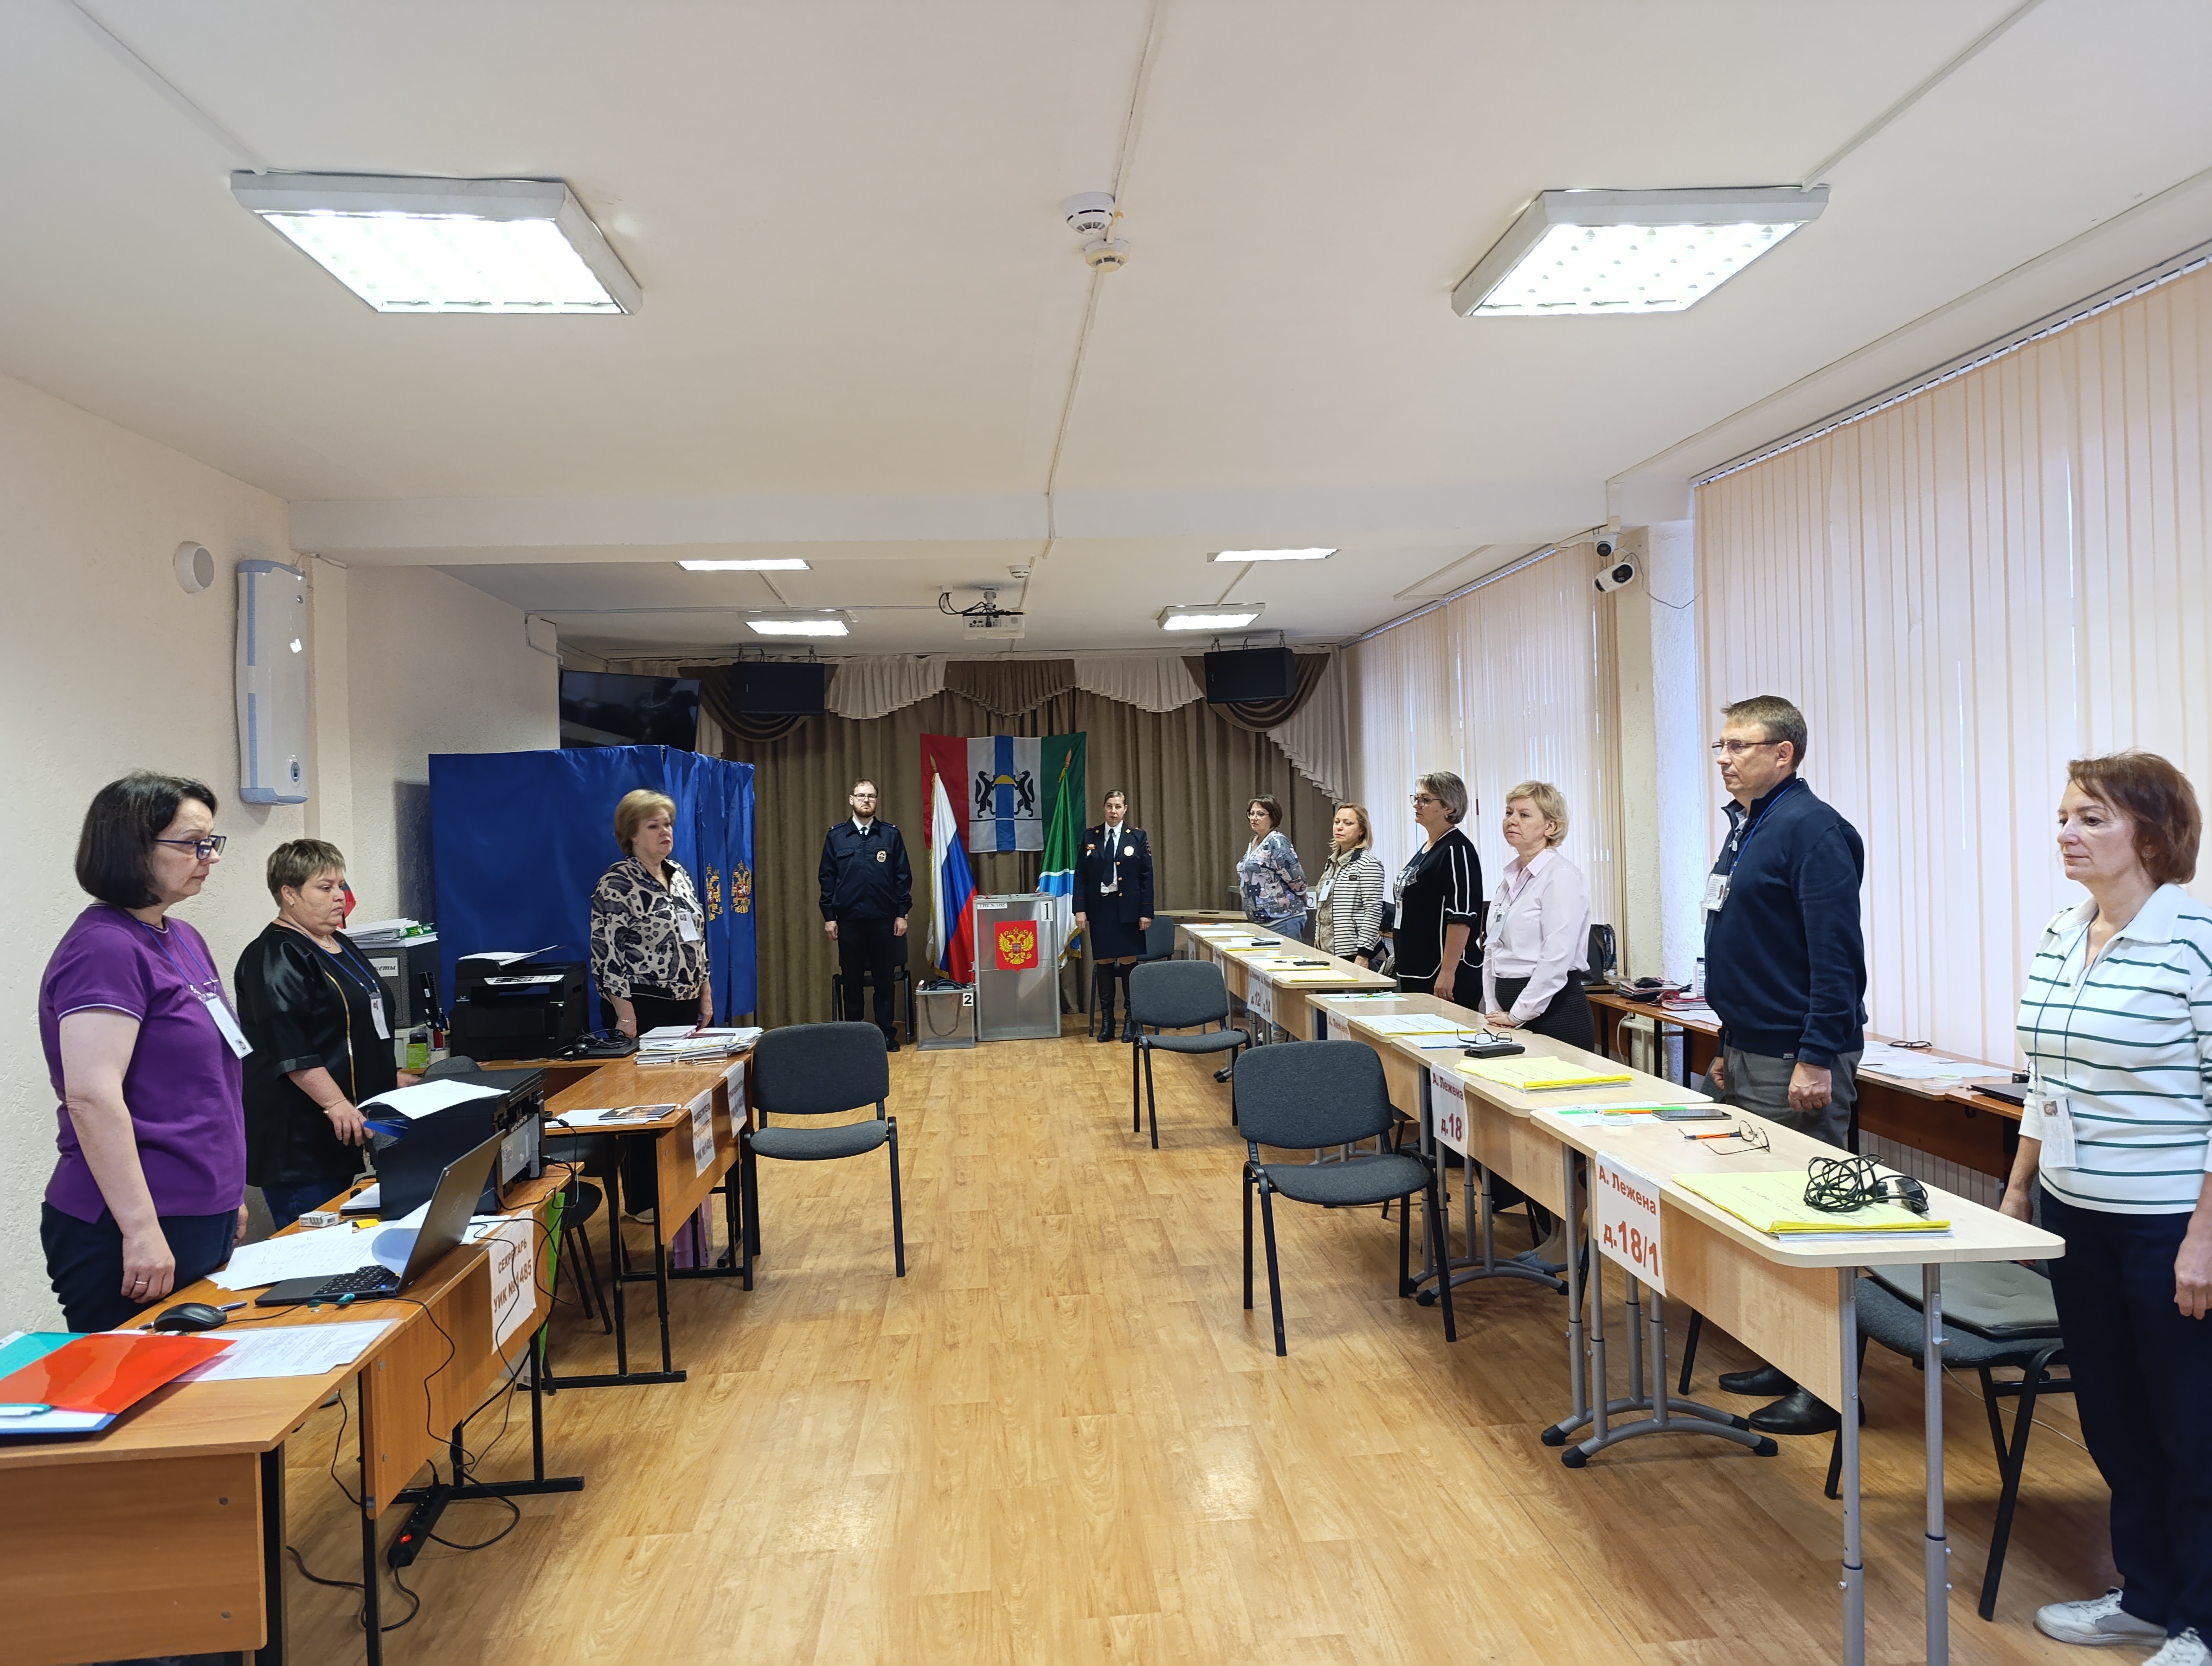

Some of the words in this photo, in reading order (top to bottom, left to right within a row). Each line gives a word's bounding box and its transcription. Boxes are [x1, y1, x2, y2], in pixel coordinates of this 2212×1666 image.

[1044, 902, 1051, 920] 1
[1307, 896, 1314, 908] 2
[964, 995, 972, 1004] 2
[1432, 1072, 1439, 1086] А.
[1439, 1076, 1464, 1100] Лежена
[1441, 1113, 1462, 1142] д.18
[1599, 1165, 1609, 1185] А.
[1612, 1172, 1656, 1216] Лежена
[498, 1238, 527, 1274] СЕКРЕТАРЬ
[1603, 1220, 1659, 1277] д.18/1
[493, 1286, 507, 1313] УИК
